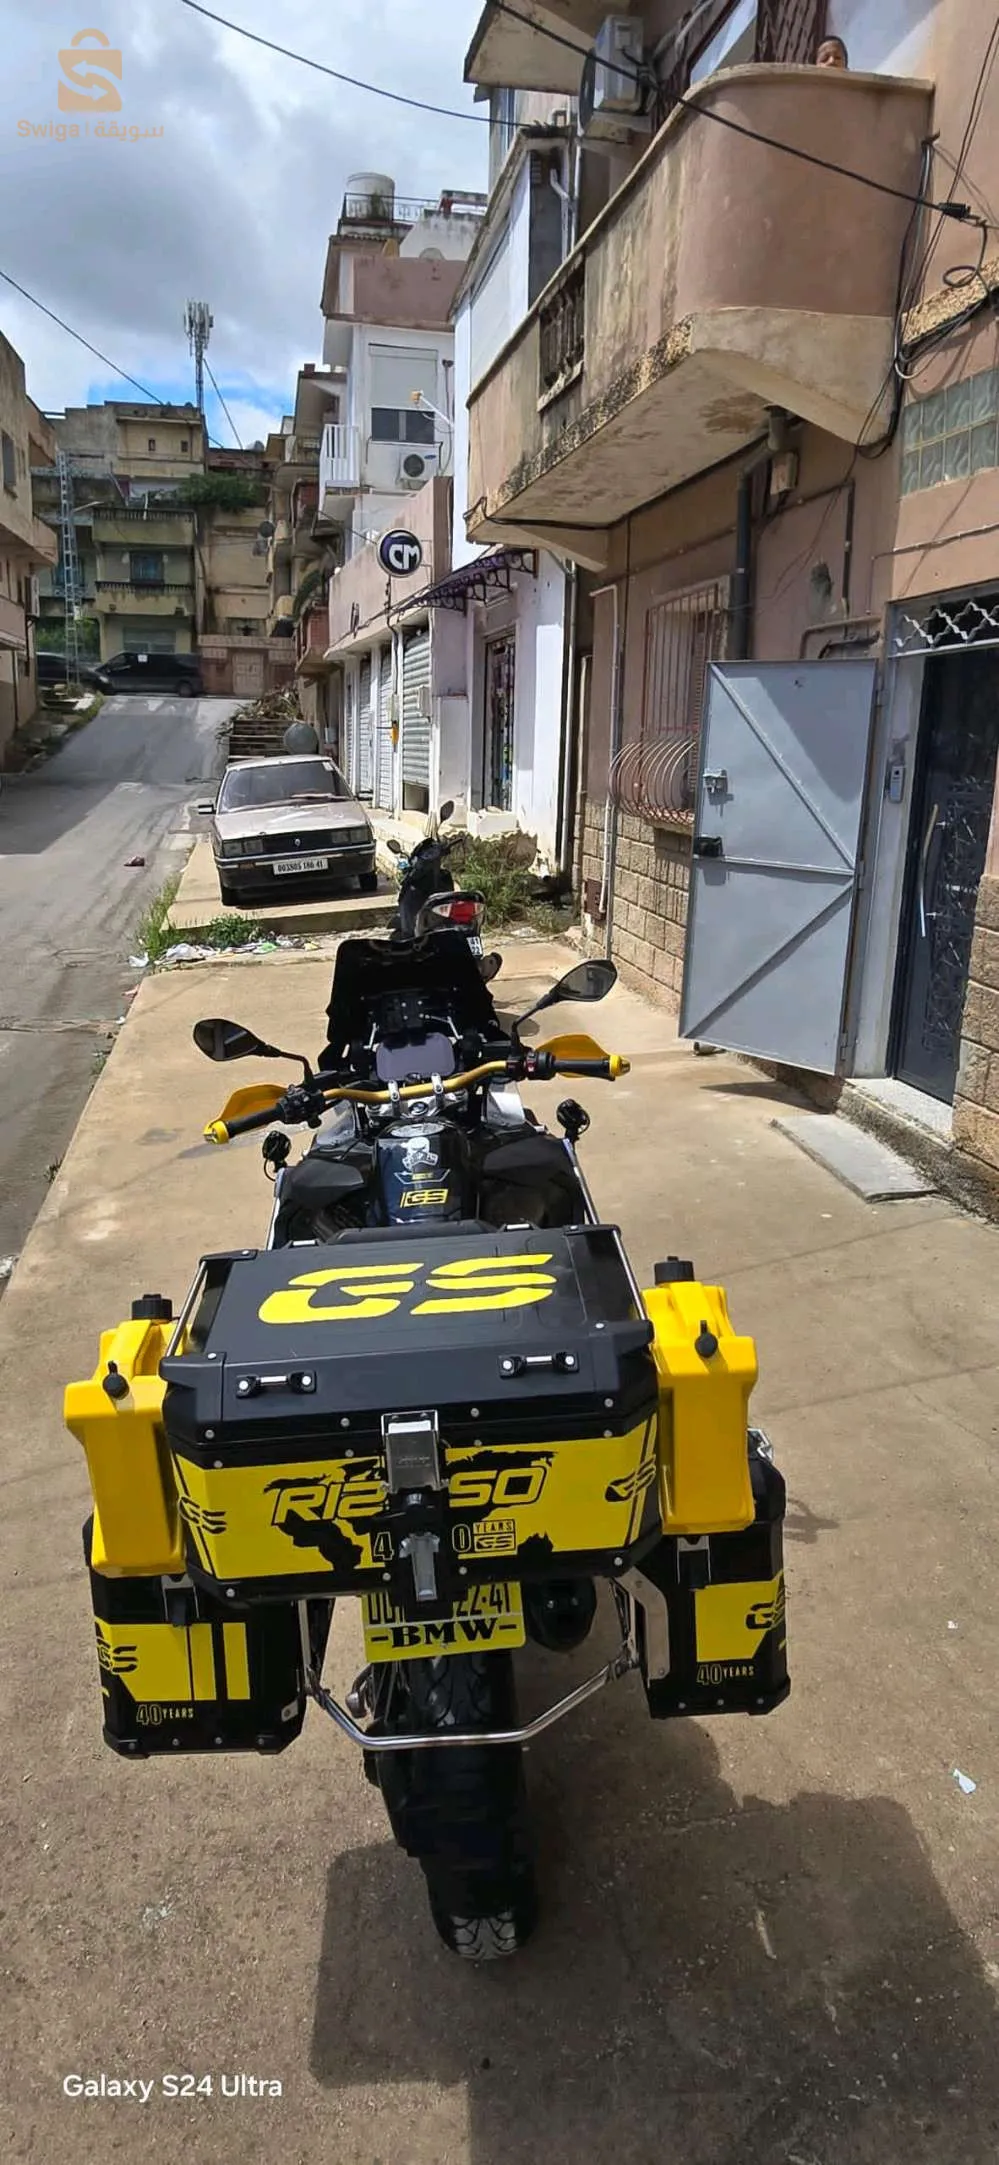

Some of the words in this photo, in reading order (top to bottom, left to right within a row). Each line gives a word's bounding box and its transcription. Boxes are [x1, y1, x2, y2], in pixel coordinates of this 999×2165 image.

[389, 543, 421, 570] CM
[406, 1190, 446, 1204] GS
[258, 1253, 557, 1325] GS
[179, 1496, 227, 1534] GS
[476, 1535, 513, 1549] GS
[696, 1664, 722, 1685] 40
[723, 1665, 755, 1679] YEARS
[136, 1704, 162, 1725] 40
[162, 1707, 194, 1720] YEARS
